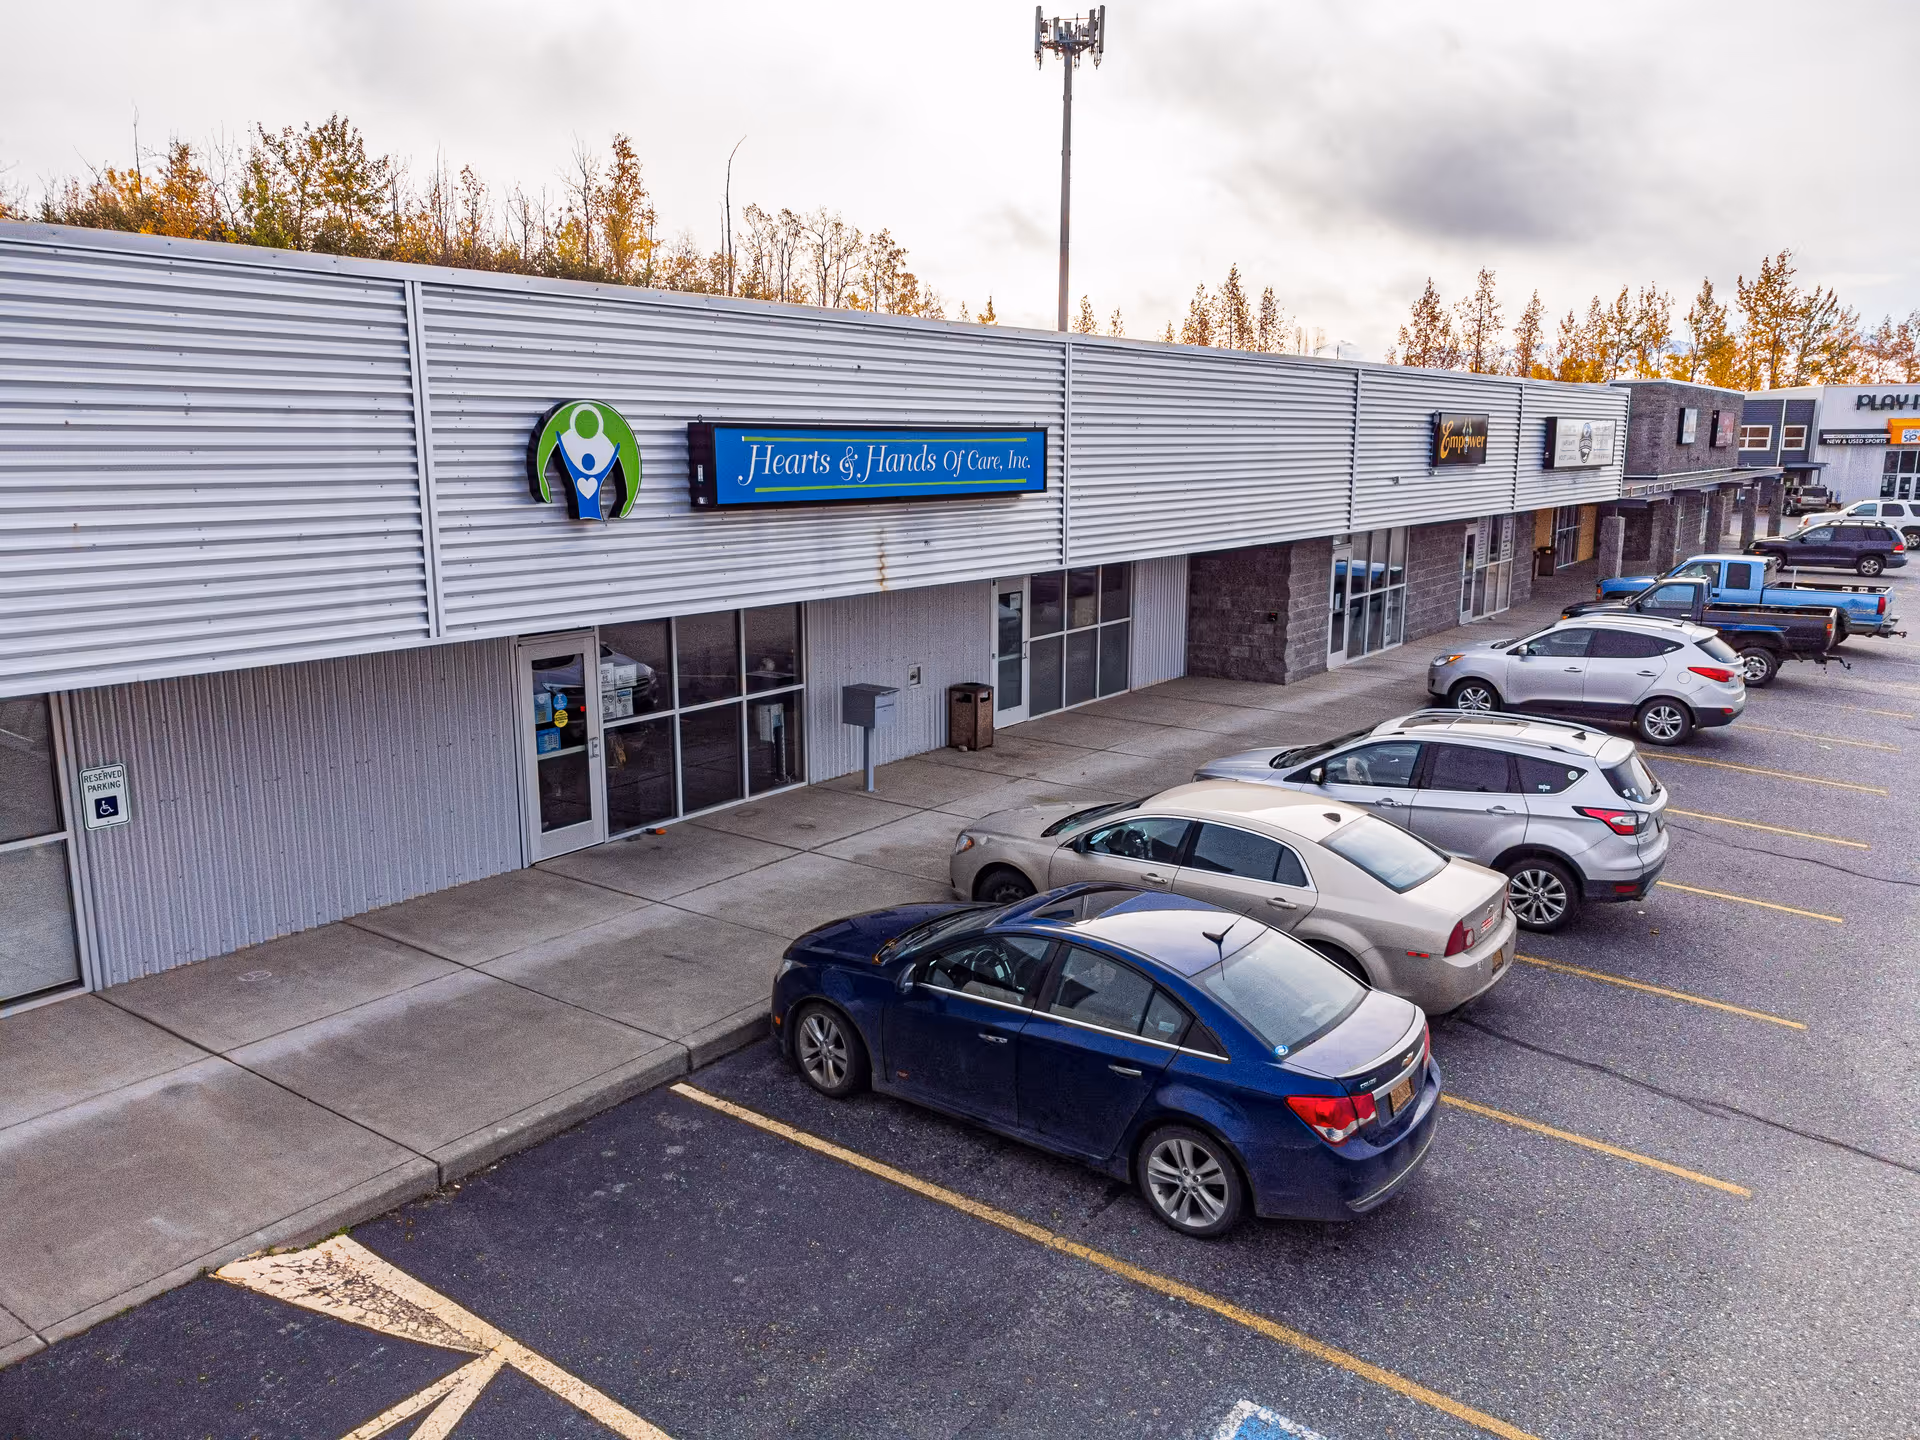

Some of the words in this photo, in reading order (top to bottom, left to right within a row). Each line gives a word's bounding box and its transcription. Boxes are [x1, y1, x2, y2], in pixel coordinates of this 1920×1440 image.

[1856, 394, 1909, 410] PLAY
[1440, 420, 1485, 459] Empower
[738, 444, 831, 486] Hearts
[839, 446, 858, 481] &
[856, 444, 936, 483] Hands
[943, 450, 965, 478] Of
[967, 449, 1003, 472] Care,
[1008, 449, 1031, 469] Inc.
[83, 769, 122, 783] RESERVED
[87, 780, 121, 793] PARKING
